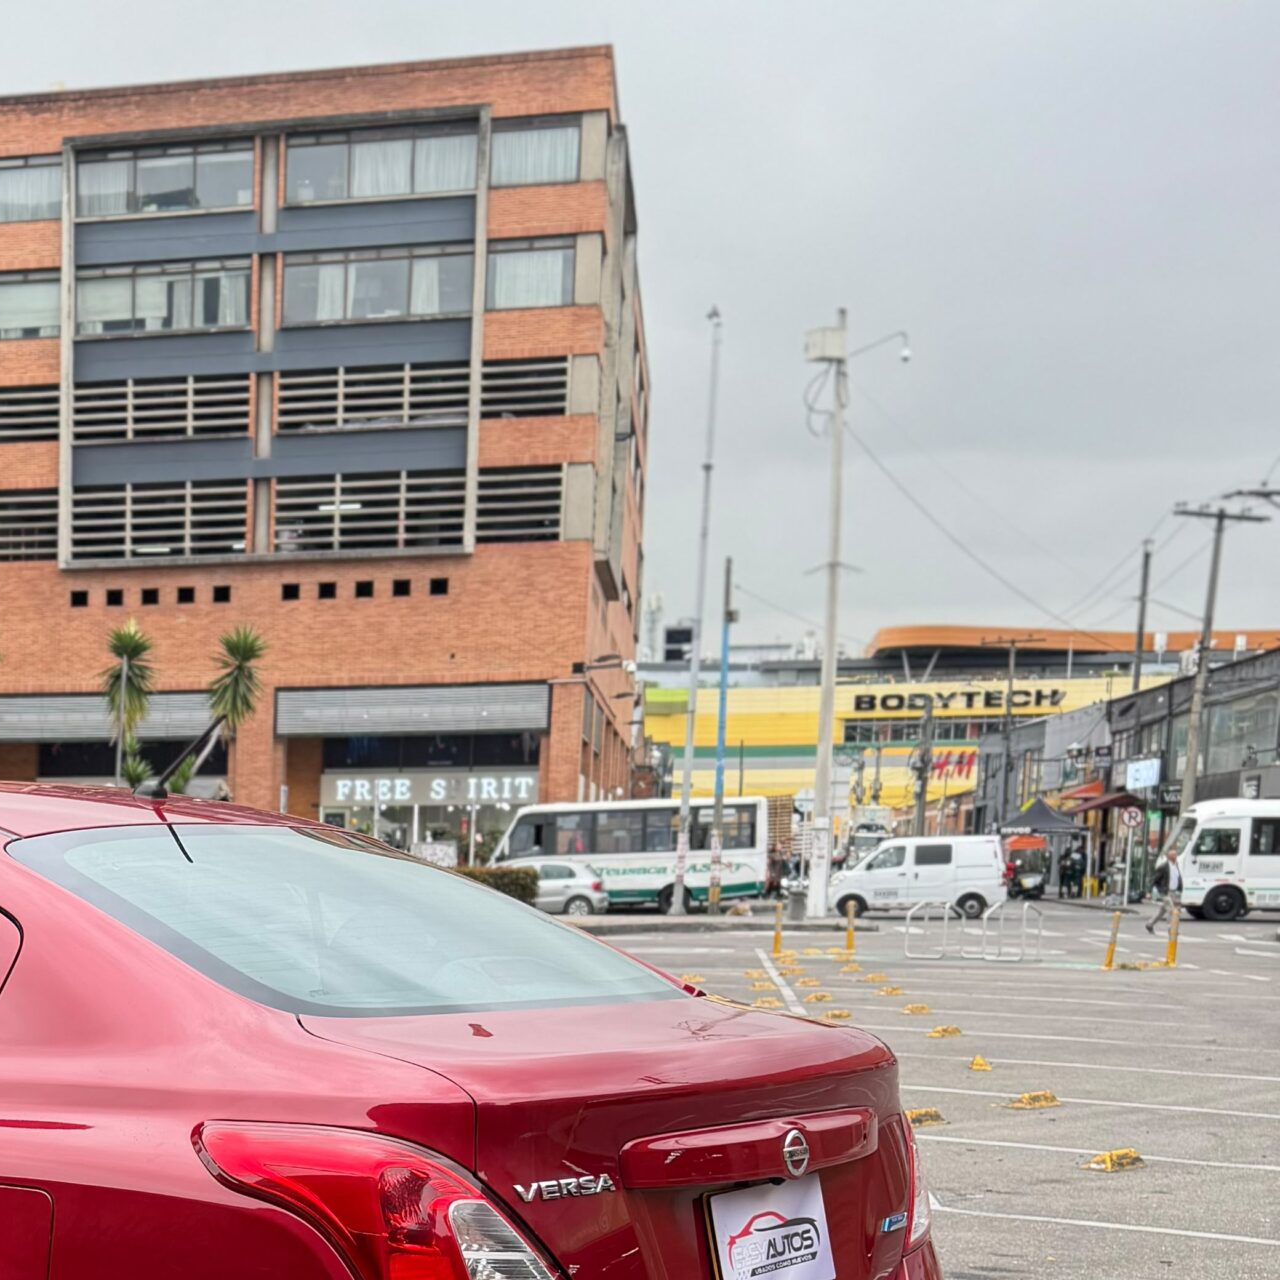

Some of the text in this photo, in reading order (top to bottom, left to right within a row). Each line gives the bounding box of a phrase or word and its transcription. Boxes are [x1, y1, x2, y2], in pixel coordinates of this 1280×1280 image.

[854, 689, 1061, 711] BODYTECH
[930, 749, 977, 780] HM
[336, 776, 534, 801] FREE SIRIT
[513, 1174, 616, 1202] VERSA
[766, 1228, 814, 1261] AUTOS
